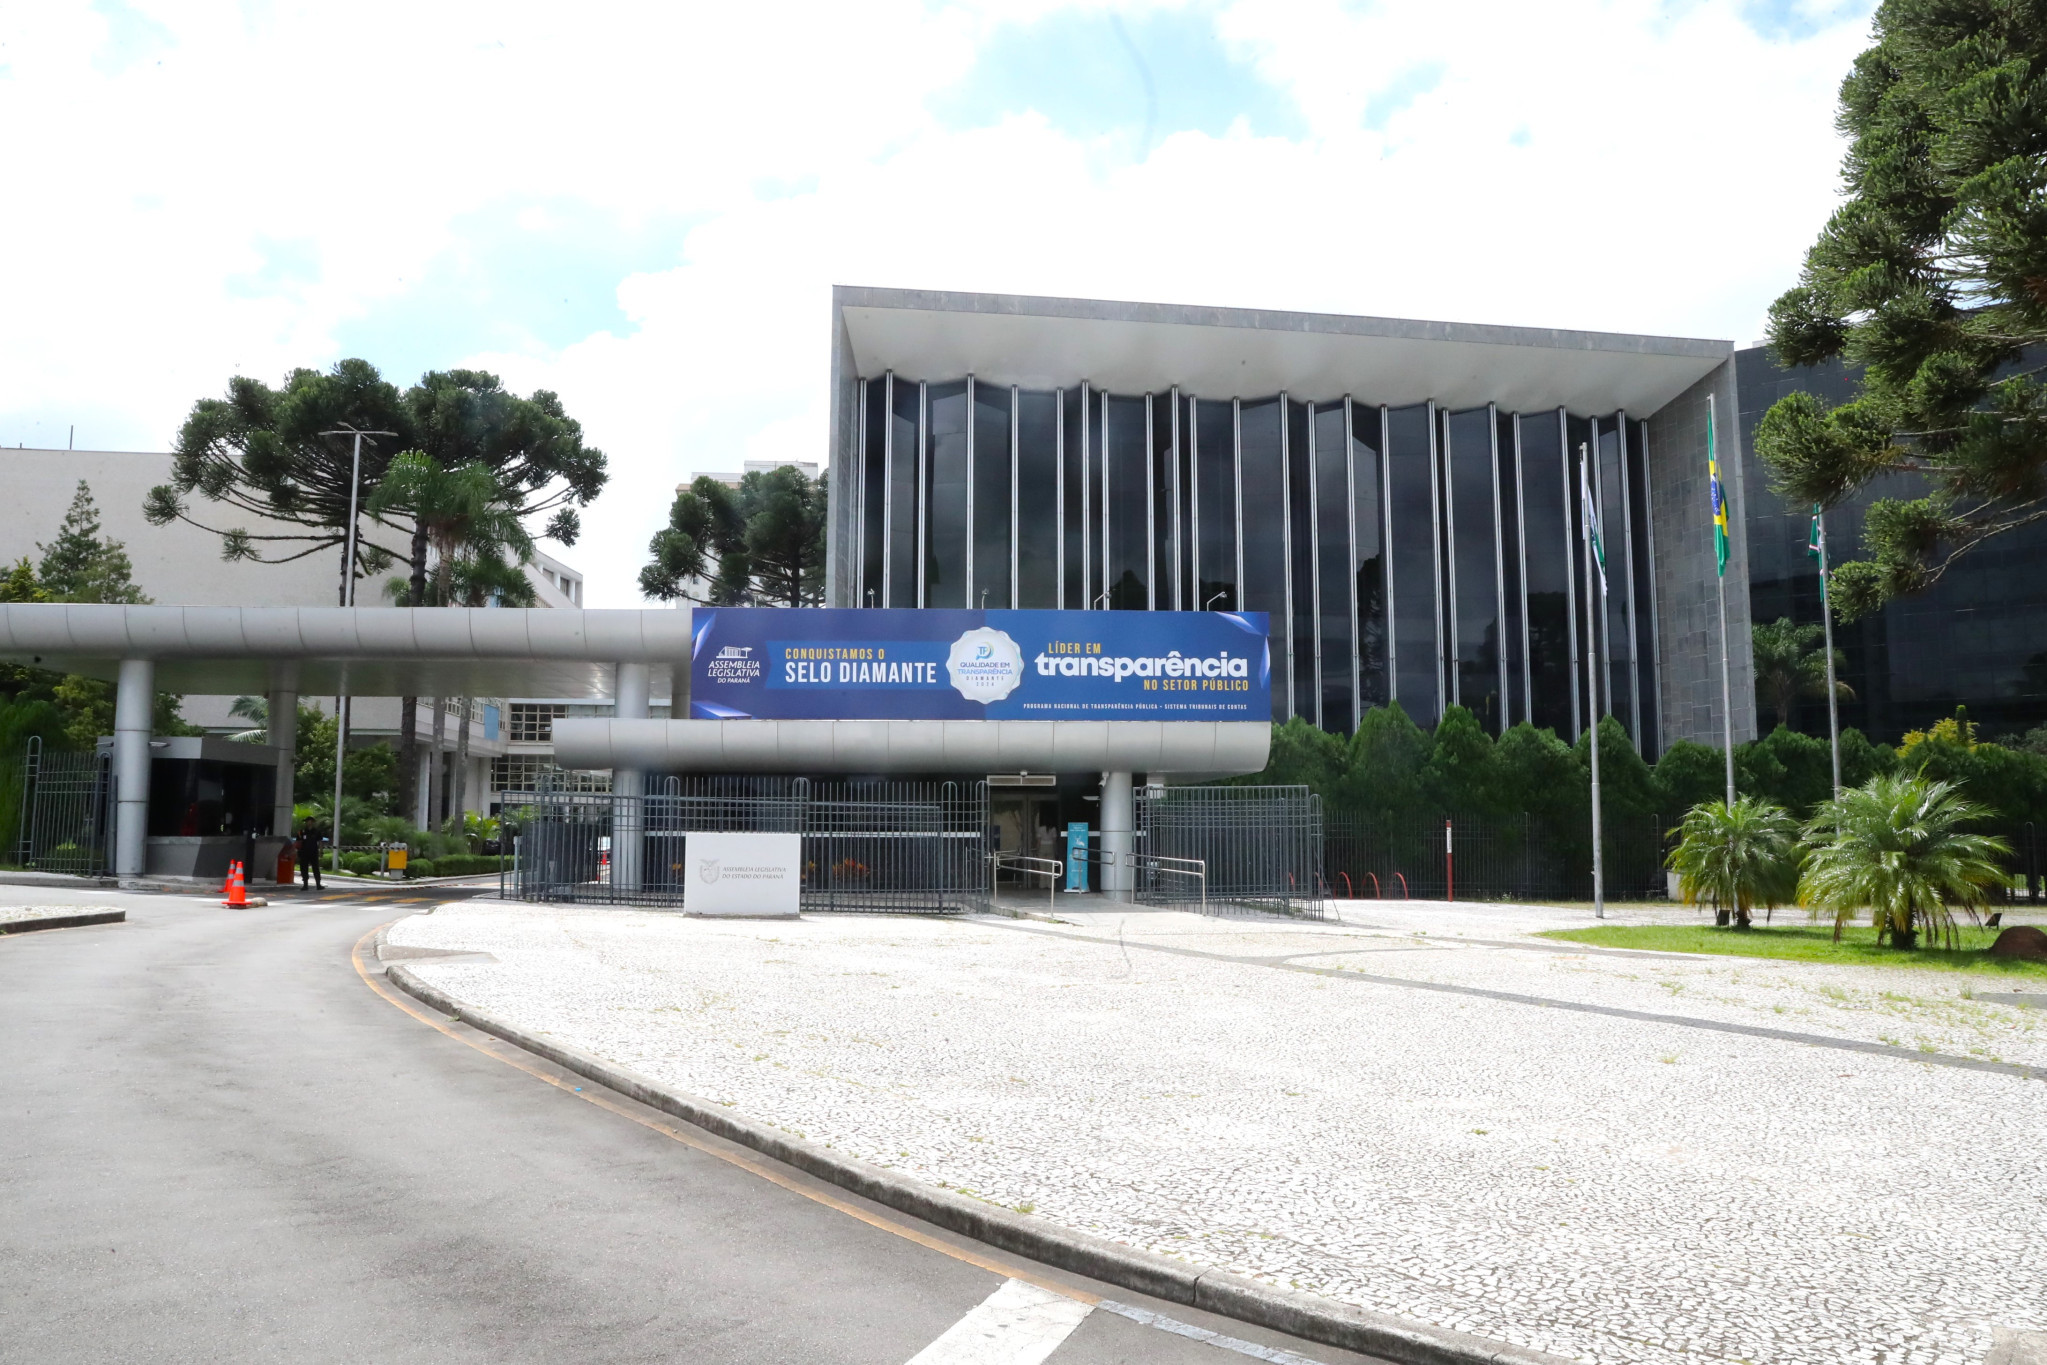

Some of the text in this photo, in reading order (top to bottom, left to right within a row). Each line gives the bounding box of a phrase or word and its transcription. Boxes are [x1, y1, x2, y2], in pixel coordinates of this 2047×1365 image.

[1048, 641, 1101, 654] LÍDER EM
[785, 648, 885, 660] CONQUISTAMOS O
[708, 660, 760, 669] ASSEMBLEIA
[1034, 651, 1248, 683] transparência
[707, 668, 760, 677] LEGISLATIVA
[785, 661, 937, 684] SELO DIAMANTE
[958, 667, 1013, 675] TRANSPARÊNCIA
[727, 676, 750, 684] PARANÁ
[1144, 677, 1249, 691] NO SETOR PÚBLICO
